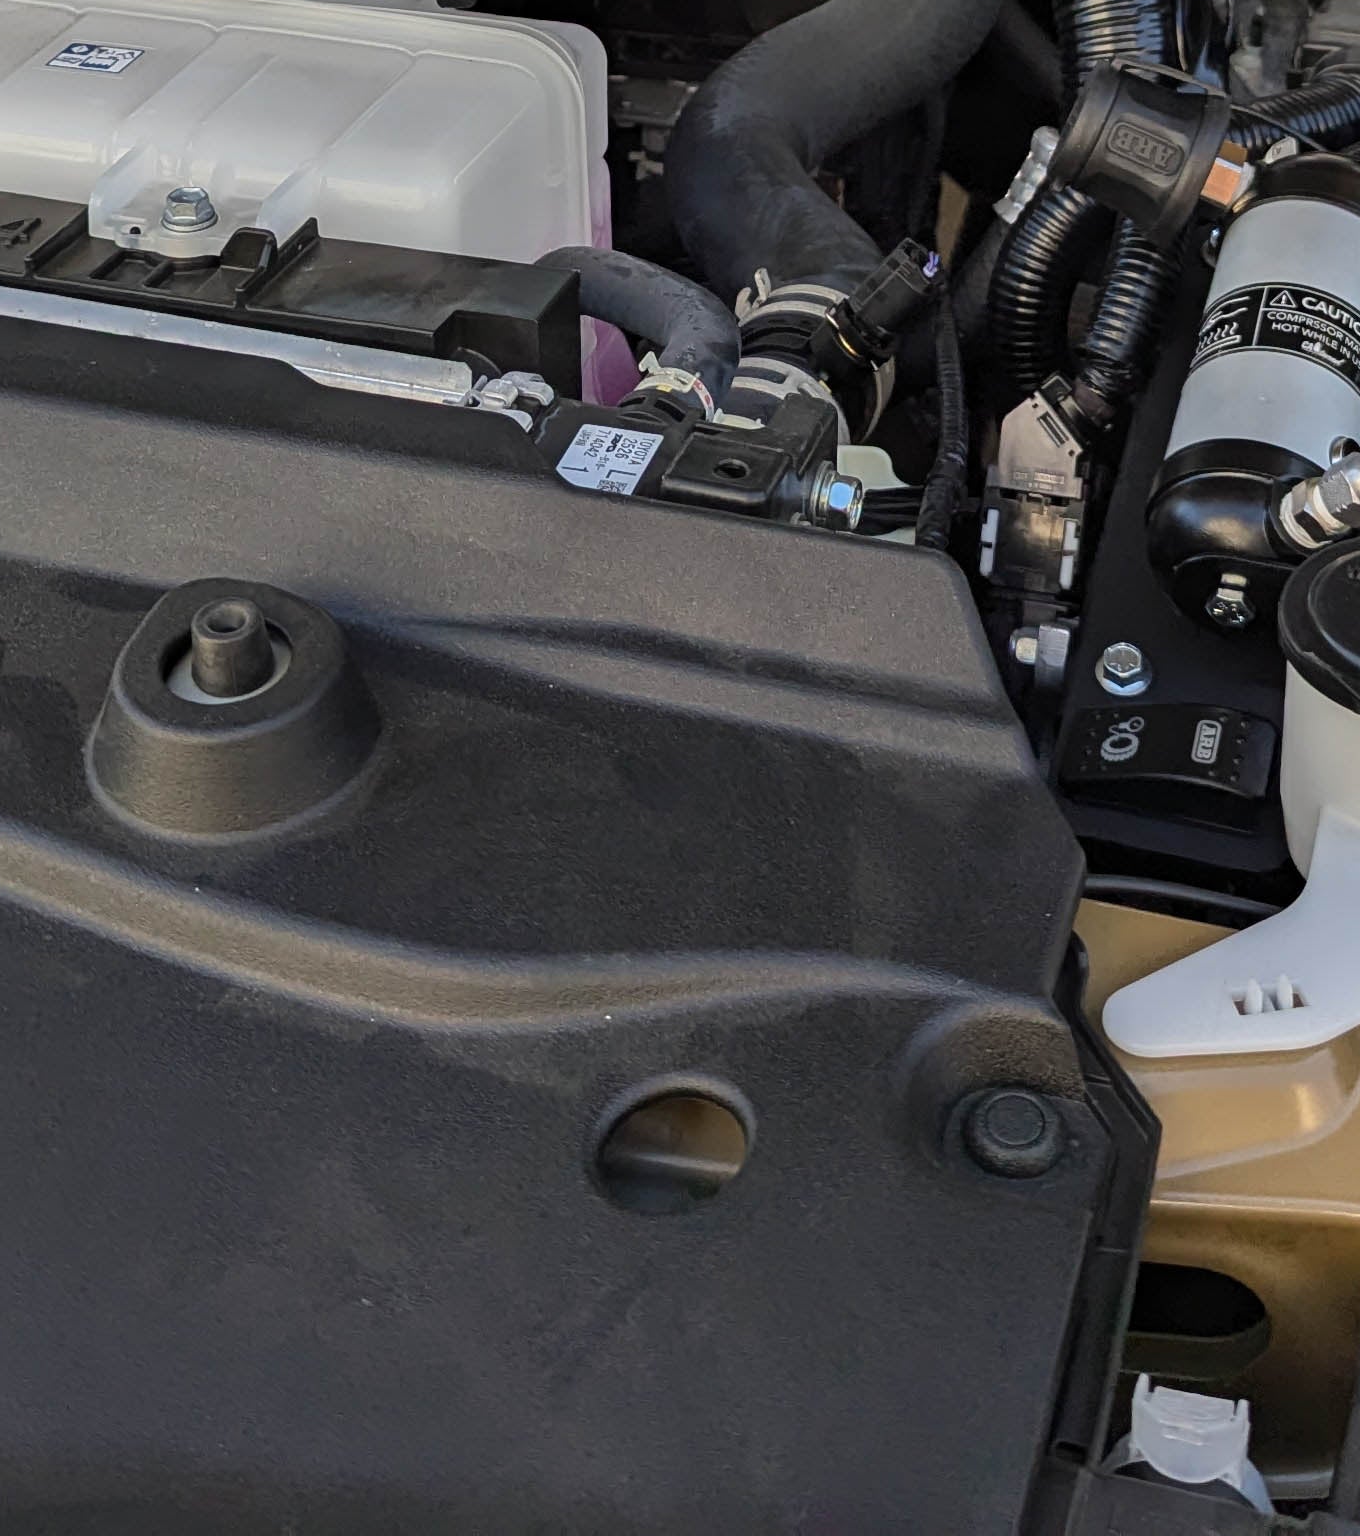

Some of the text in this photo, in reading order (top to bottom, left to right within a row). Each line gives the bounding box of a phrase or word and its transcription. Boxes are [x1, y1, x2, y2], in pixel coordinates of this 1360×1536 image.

[1115, 129, 1176, 169] ARB
[1266, 311, 1344, 343] COMPRSSOR
[1272, 322, 1300, 334] HOT
[1301, 326, 1338, 352] WHILE
[1340, 343, 1351, 359] IN
[628, 438, 656, 465] TOYOTA
